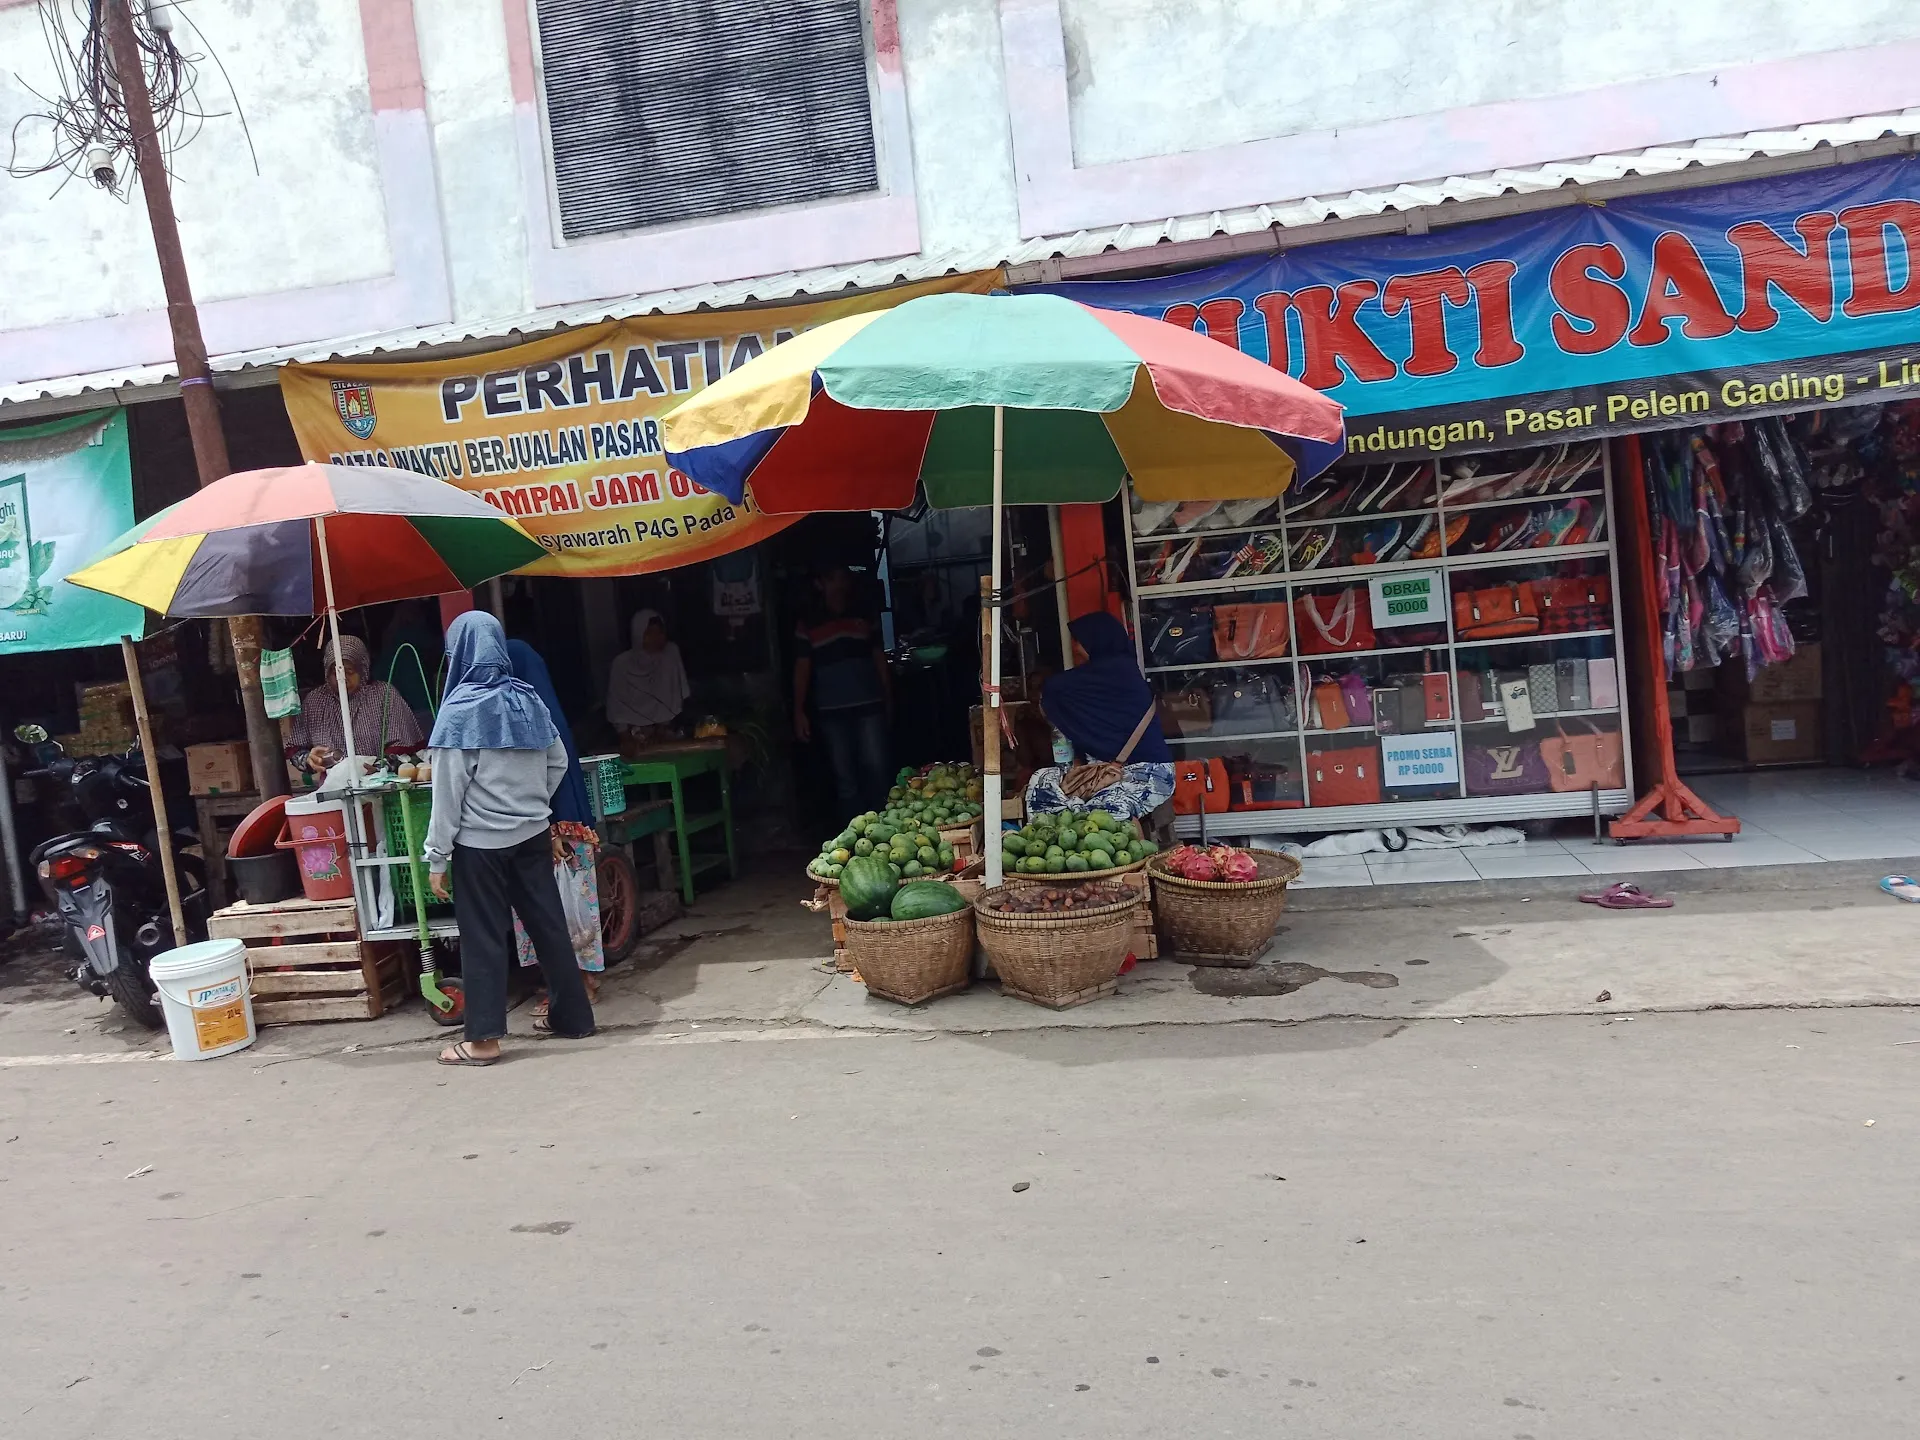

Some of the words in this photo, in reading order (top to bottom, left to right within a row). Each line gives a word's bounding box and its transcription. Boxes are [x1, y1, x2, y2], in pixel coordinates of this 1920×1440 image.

[442, 327, 812, 420] PERHATIA
[1505, 403, 1597, 436] Pasar
[1607, 390, 1710, 422] Pelem
[1721, 372, 1845, 408] Gading
[466, 430, 587, 474] BERJUALAN
[593, 420, 660, 458] PASAR
[472, 483, 580, 516] AMPAI
[590, 473, 660, 508] JAM
[634, 517, 679, 542] P4G
[683, 505, 736, 535] Pada
[1382, 581, 1430, 596] OBRAL
[1388, 599, 1428, 614] 50000
[1387, 749, 1421, 761] PROMO
[1422, 747, 1453, 760] SERBA
[1398, 764, 1411, 776] RP
[1412, 762, 1444, 775] 50000
